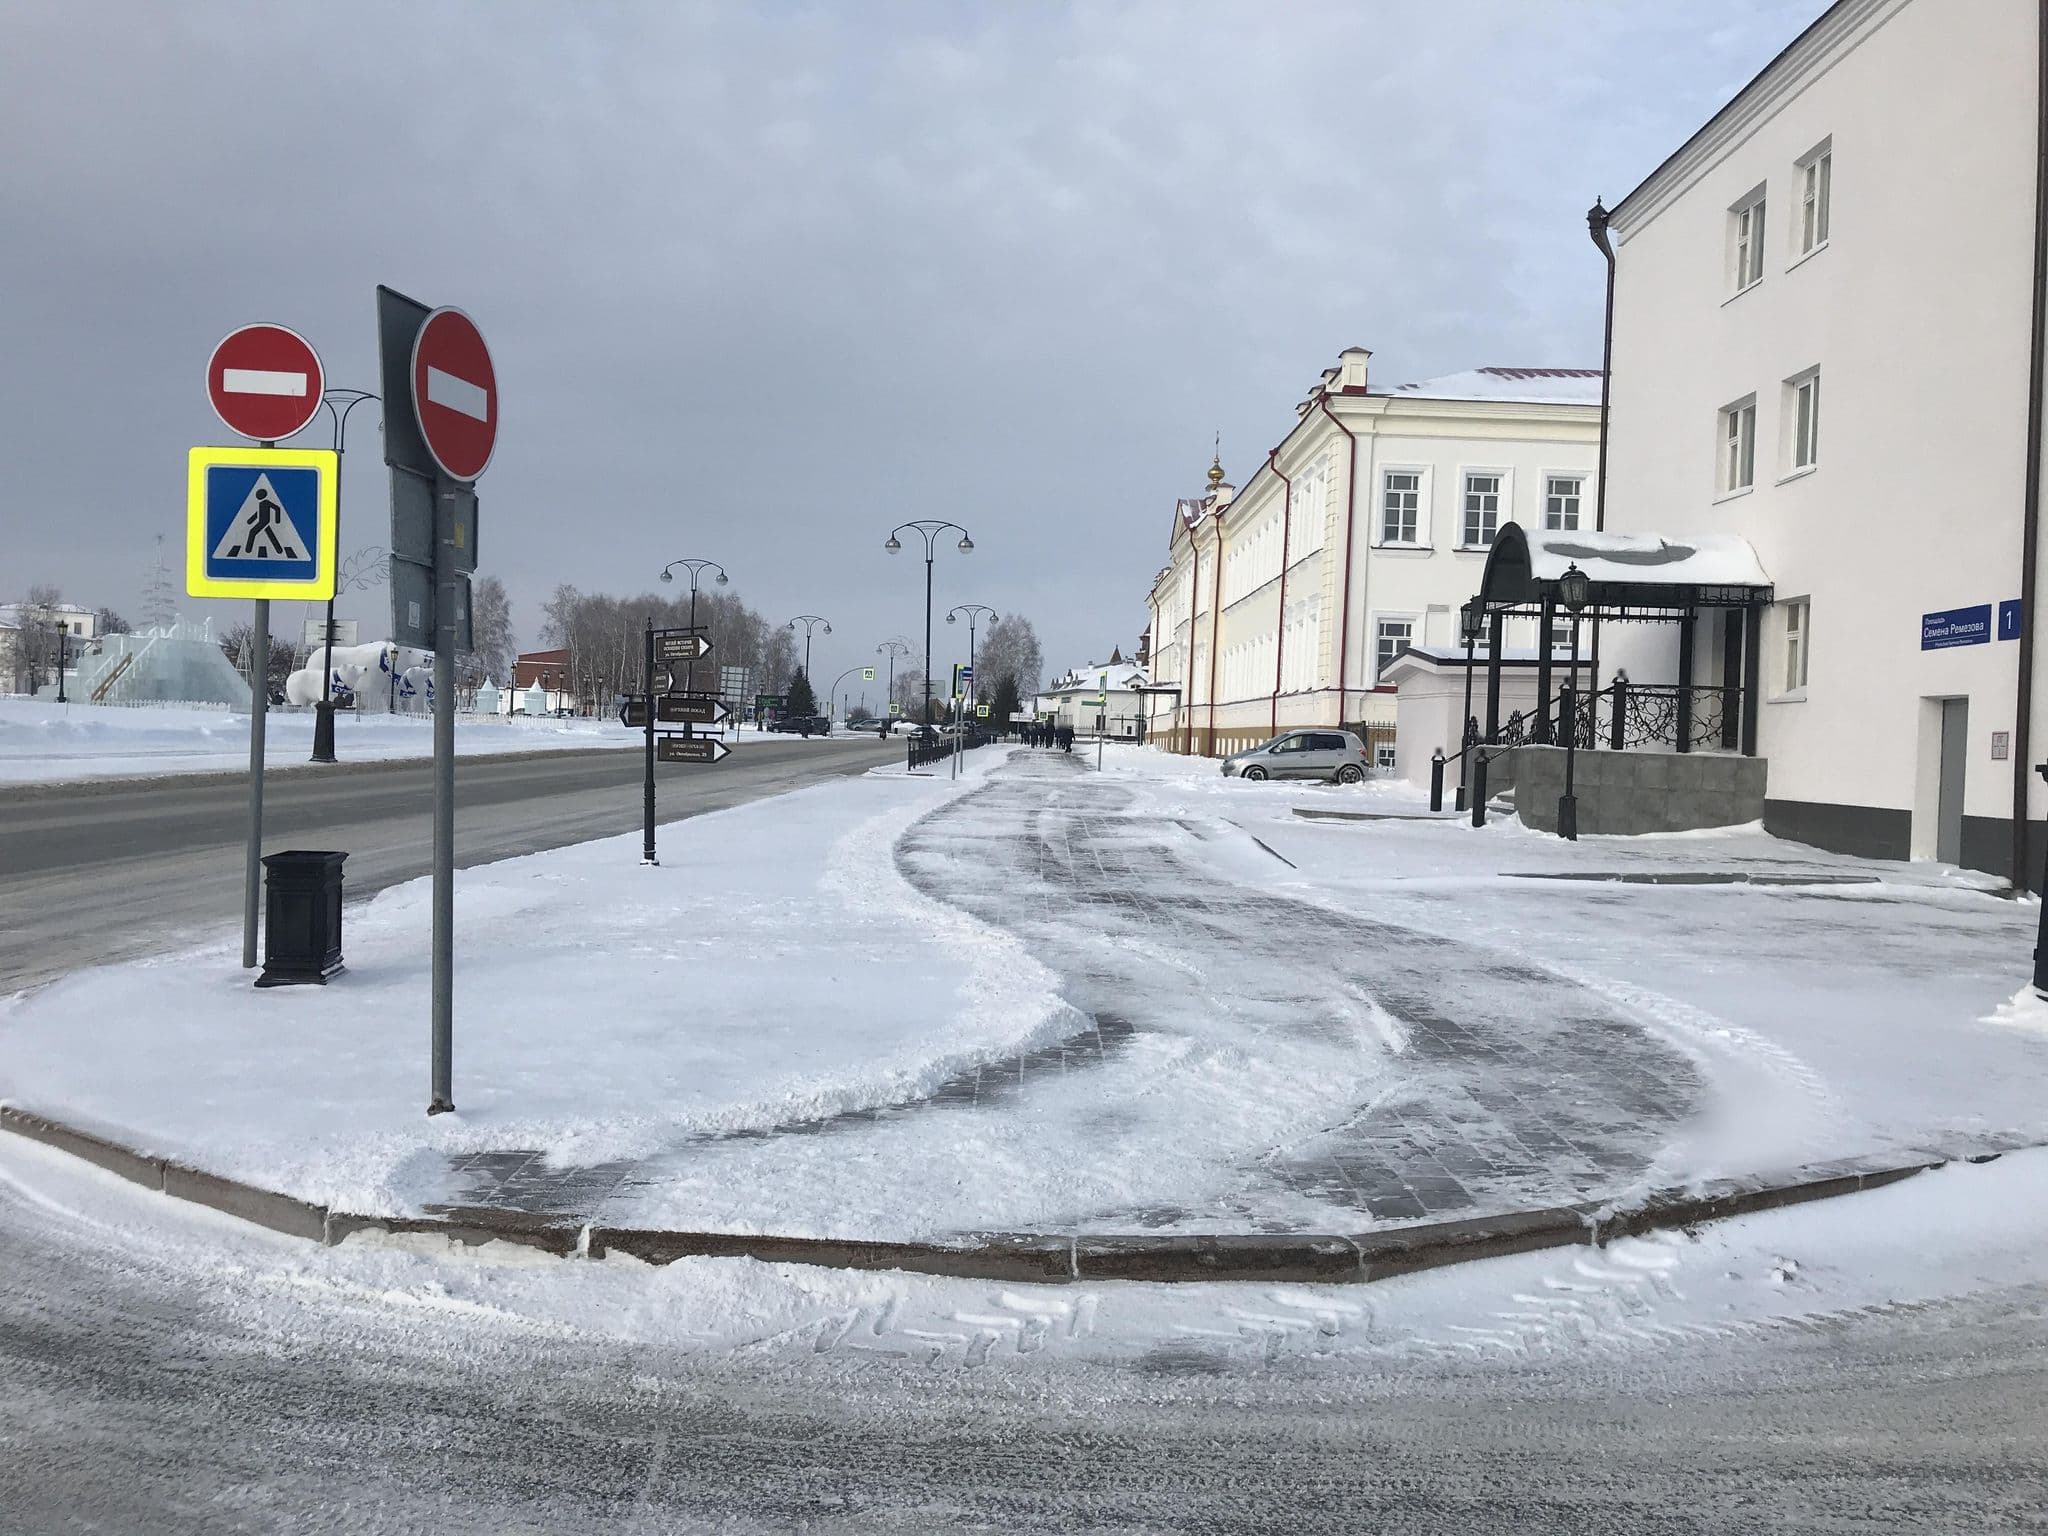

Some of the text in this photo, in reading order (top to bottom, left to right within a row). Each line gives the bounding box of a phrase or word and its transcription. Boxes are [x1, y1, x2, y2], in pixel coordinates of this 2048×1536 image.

[2006, 610, 2012, 630] 1
[1923, 622, 1984, 638] Семена Ремезова
